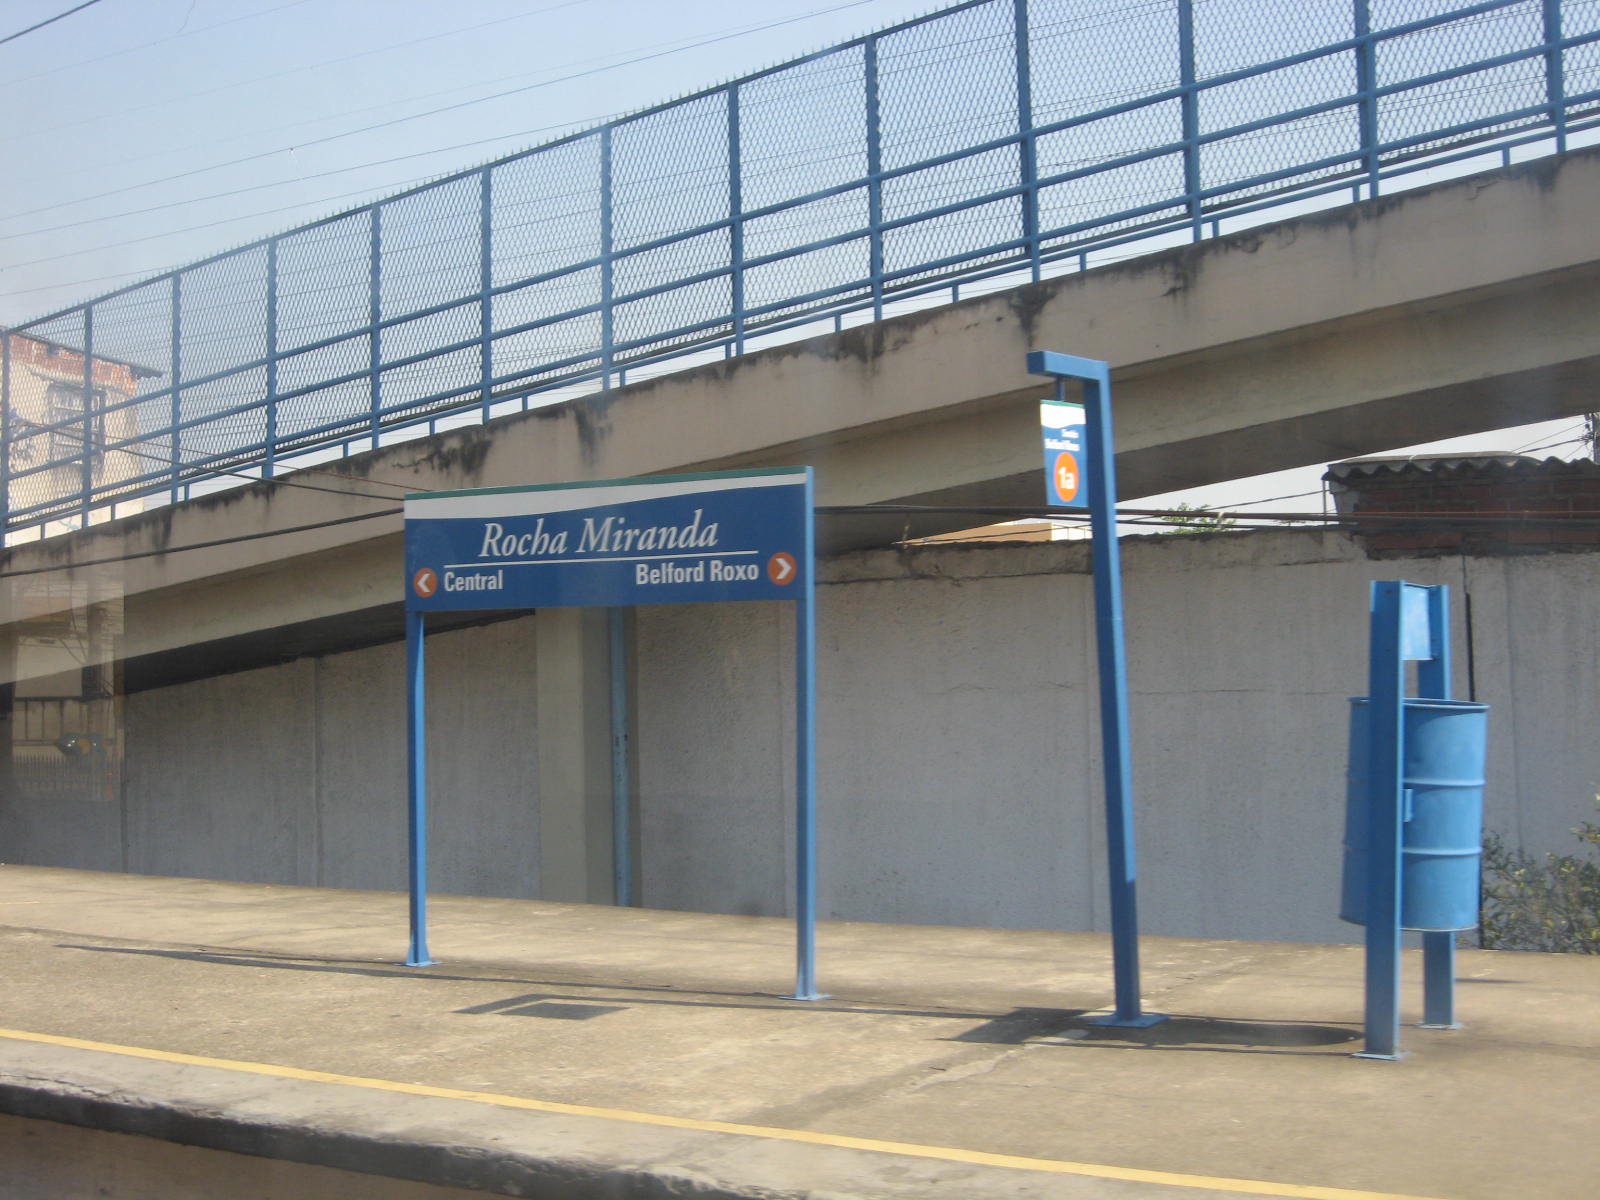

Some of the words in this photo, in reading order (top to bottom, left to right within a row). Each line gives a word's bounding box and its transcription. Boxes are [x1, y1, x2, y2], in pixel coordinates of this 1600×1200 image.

[479, 518, 567, 557] Rocha
[578, 509, 719, 553] Miranda
[444, 570, 503, 592] Central
[636, 561, 703, 585] Belford
[710, 560, 758, 582] Roxo
